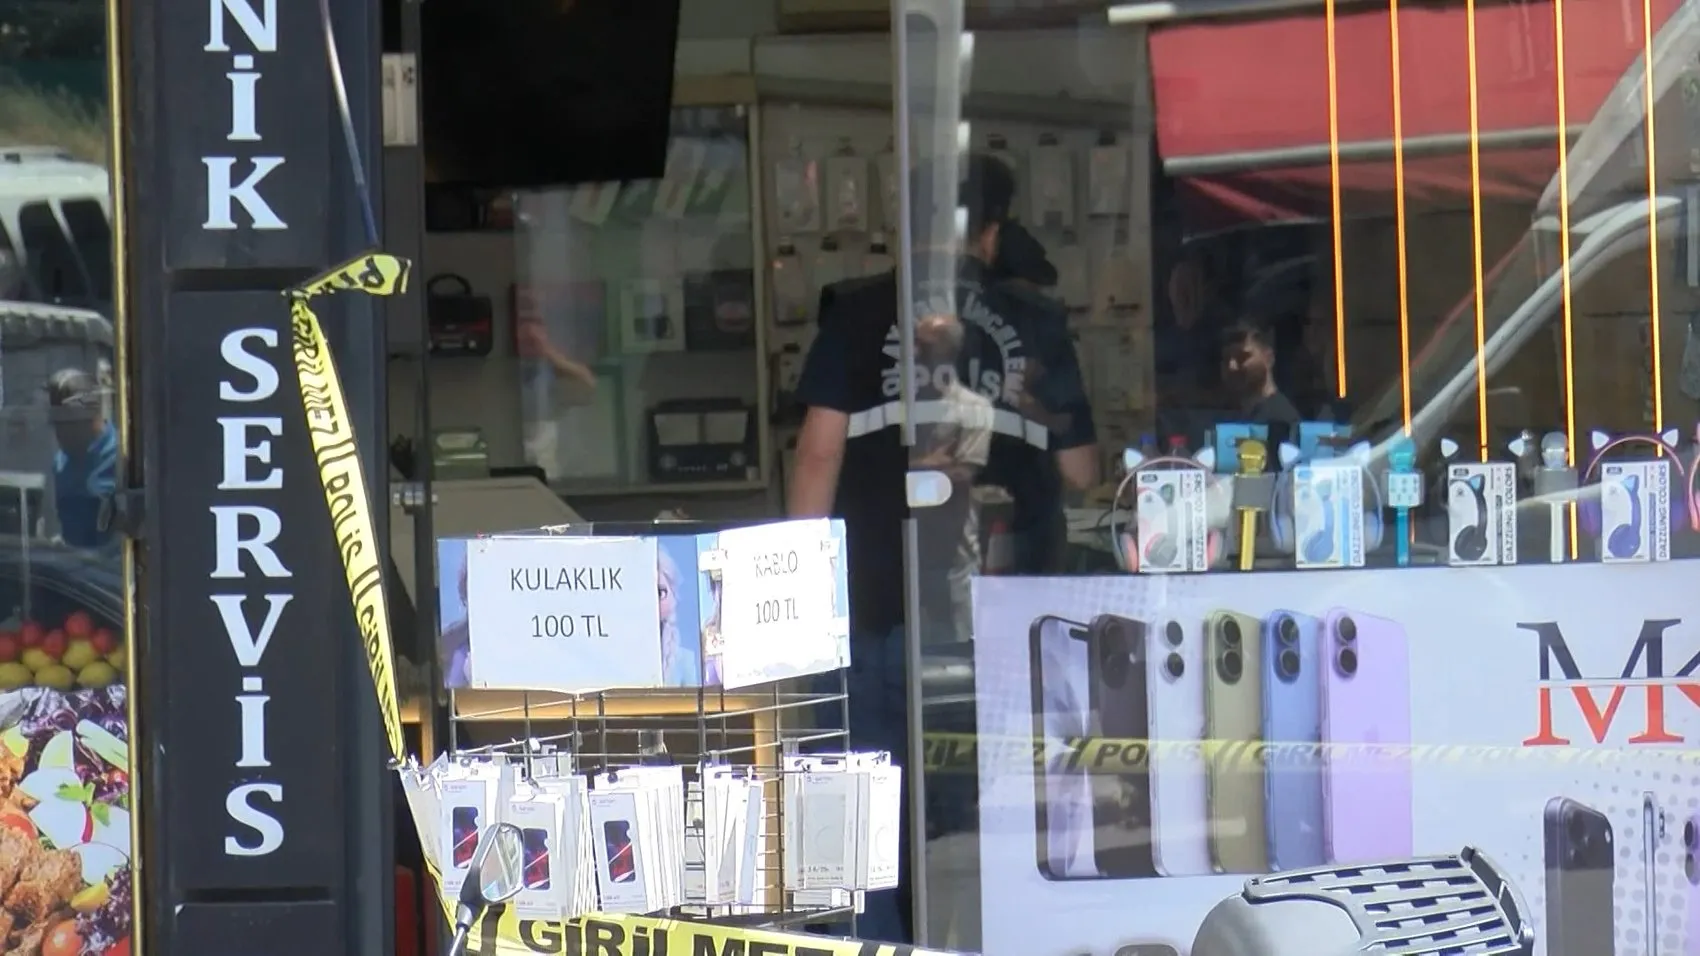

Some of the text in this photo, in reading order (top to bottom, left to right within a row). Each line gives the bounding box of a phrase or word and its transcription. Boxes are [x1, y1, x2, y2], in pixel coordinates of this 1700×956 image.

[1658, 464, 1668, 558] DAZZLING COLORS
[753, 549, 798, 578] KABLO
[209, 327, 293, 856] SERVİS
[510, 567, 623, 591] KULAKLIK
[755, 597, 799, 625] 100 TL
[531, 614, 609, 639] 100 TL
